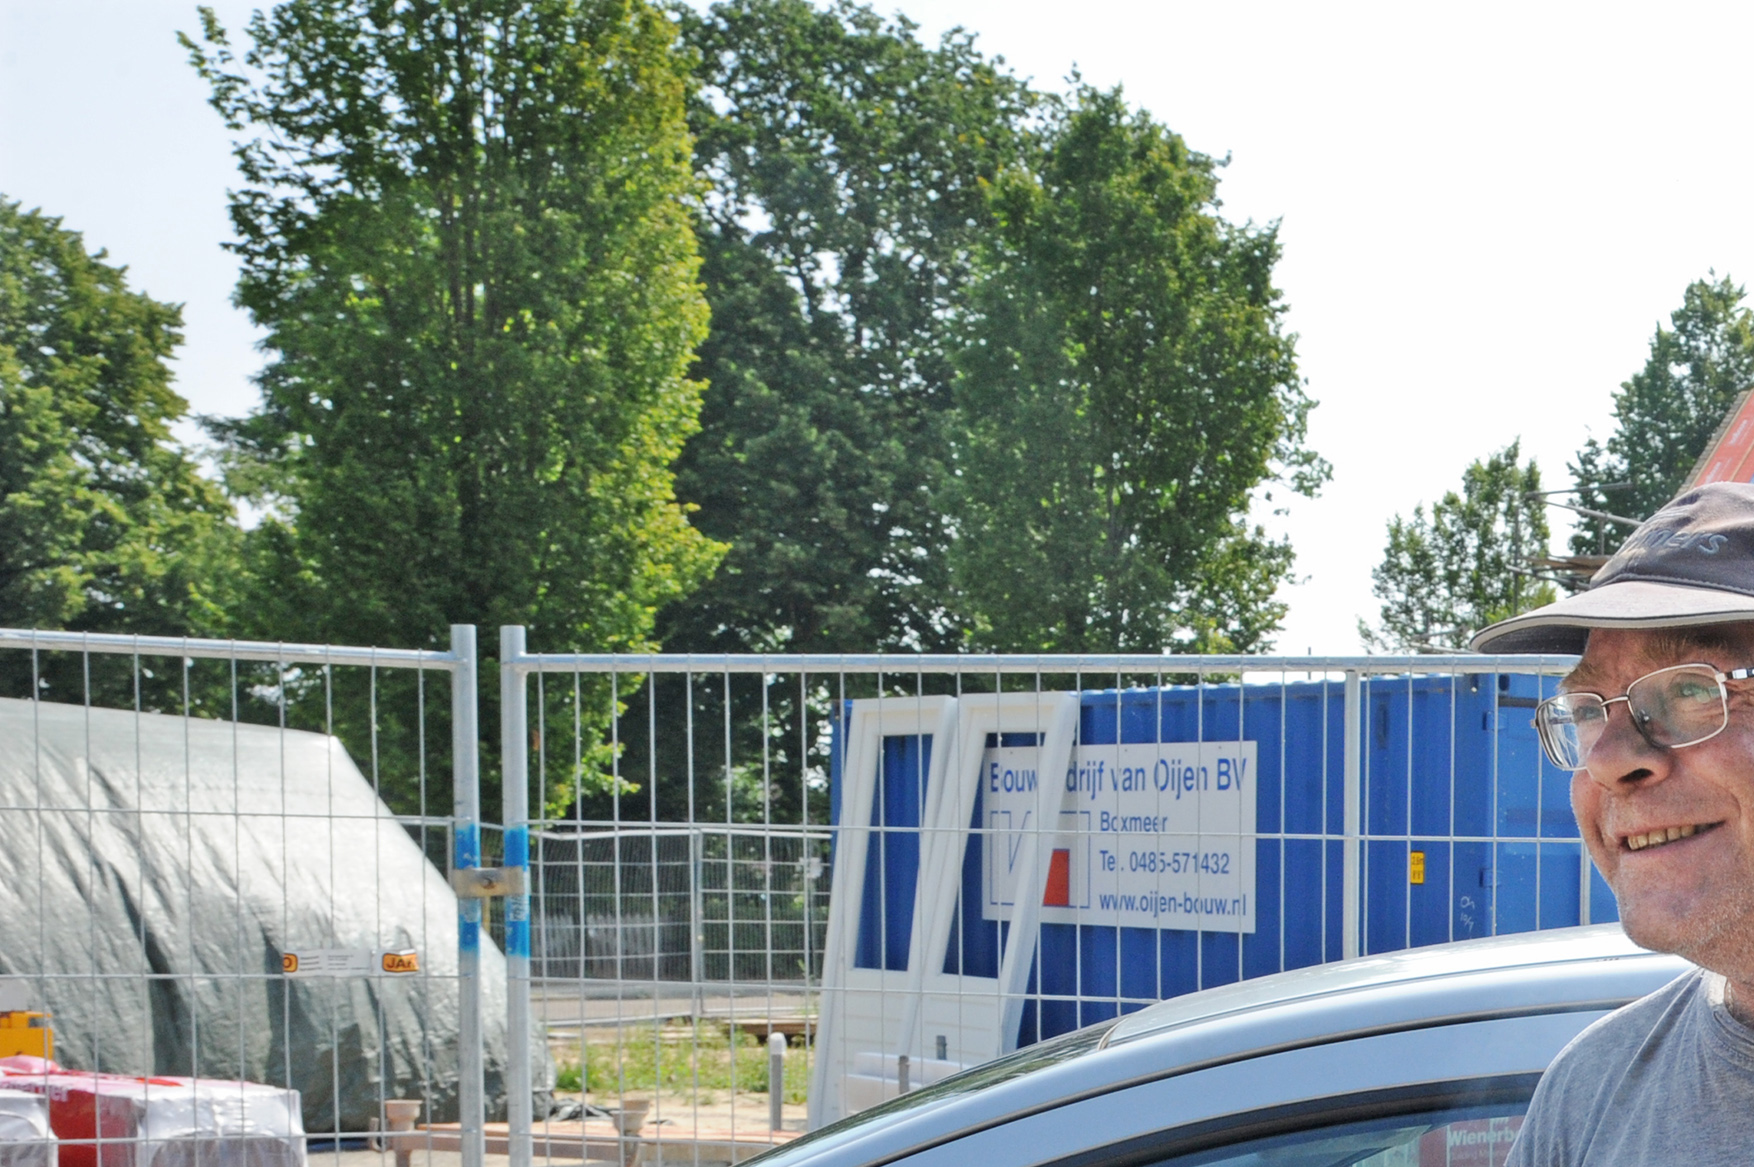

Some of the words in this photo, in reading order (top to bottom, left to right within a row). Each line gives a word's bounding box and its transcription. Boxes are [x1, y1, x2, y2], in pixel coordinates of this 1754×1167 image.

[990, 760, 1104, 800] Bouwdrijf
[1110, 767, 1146, 792] van
[1154, 758, 1208, 800] Oijen
[1217, 758, 1247, 791] BV
[1099, 850, 1124, 872] Te.
[1130, 851, 1230, 874] 0485-571432
[1099, 891, 1246, 918] www.oijen-bouw.nl
